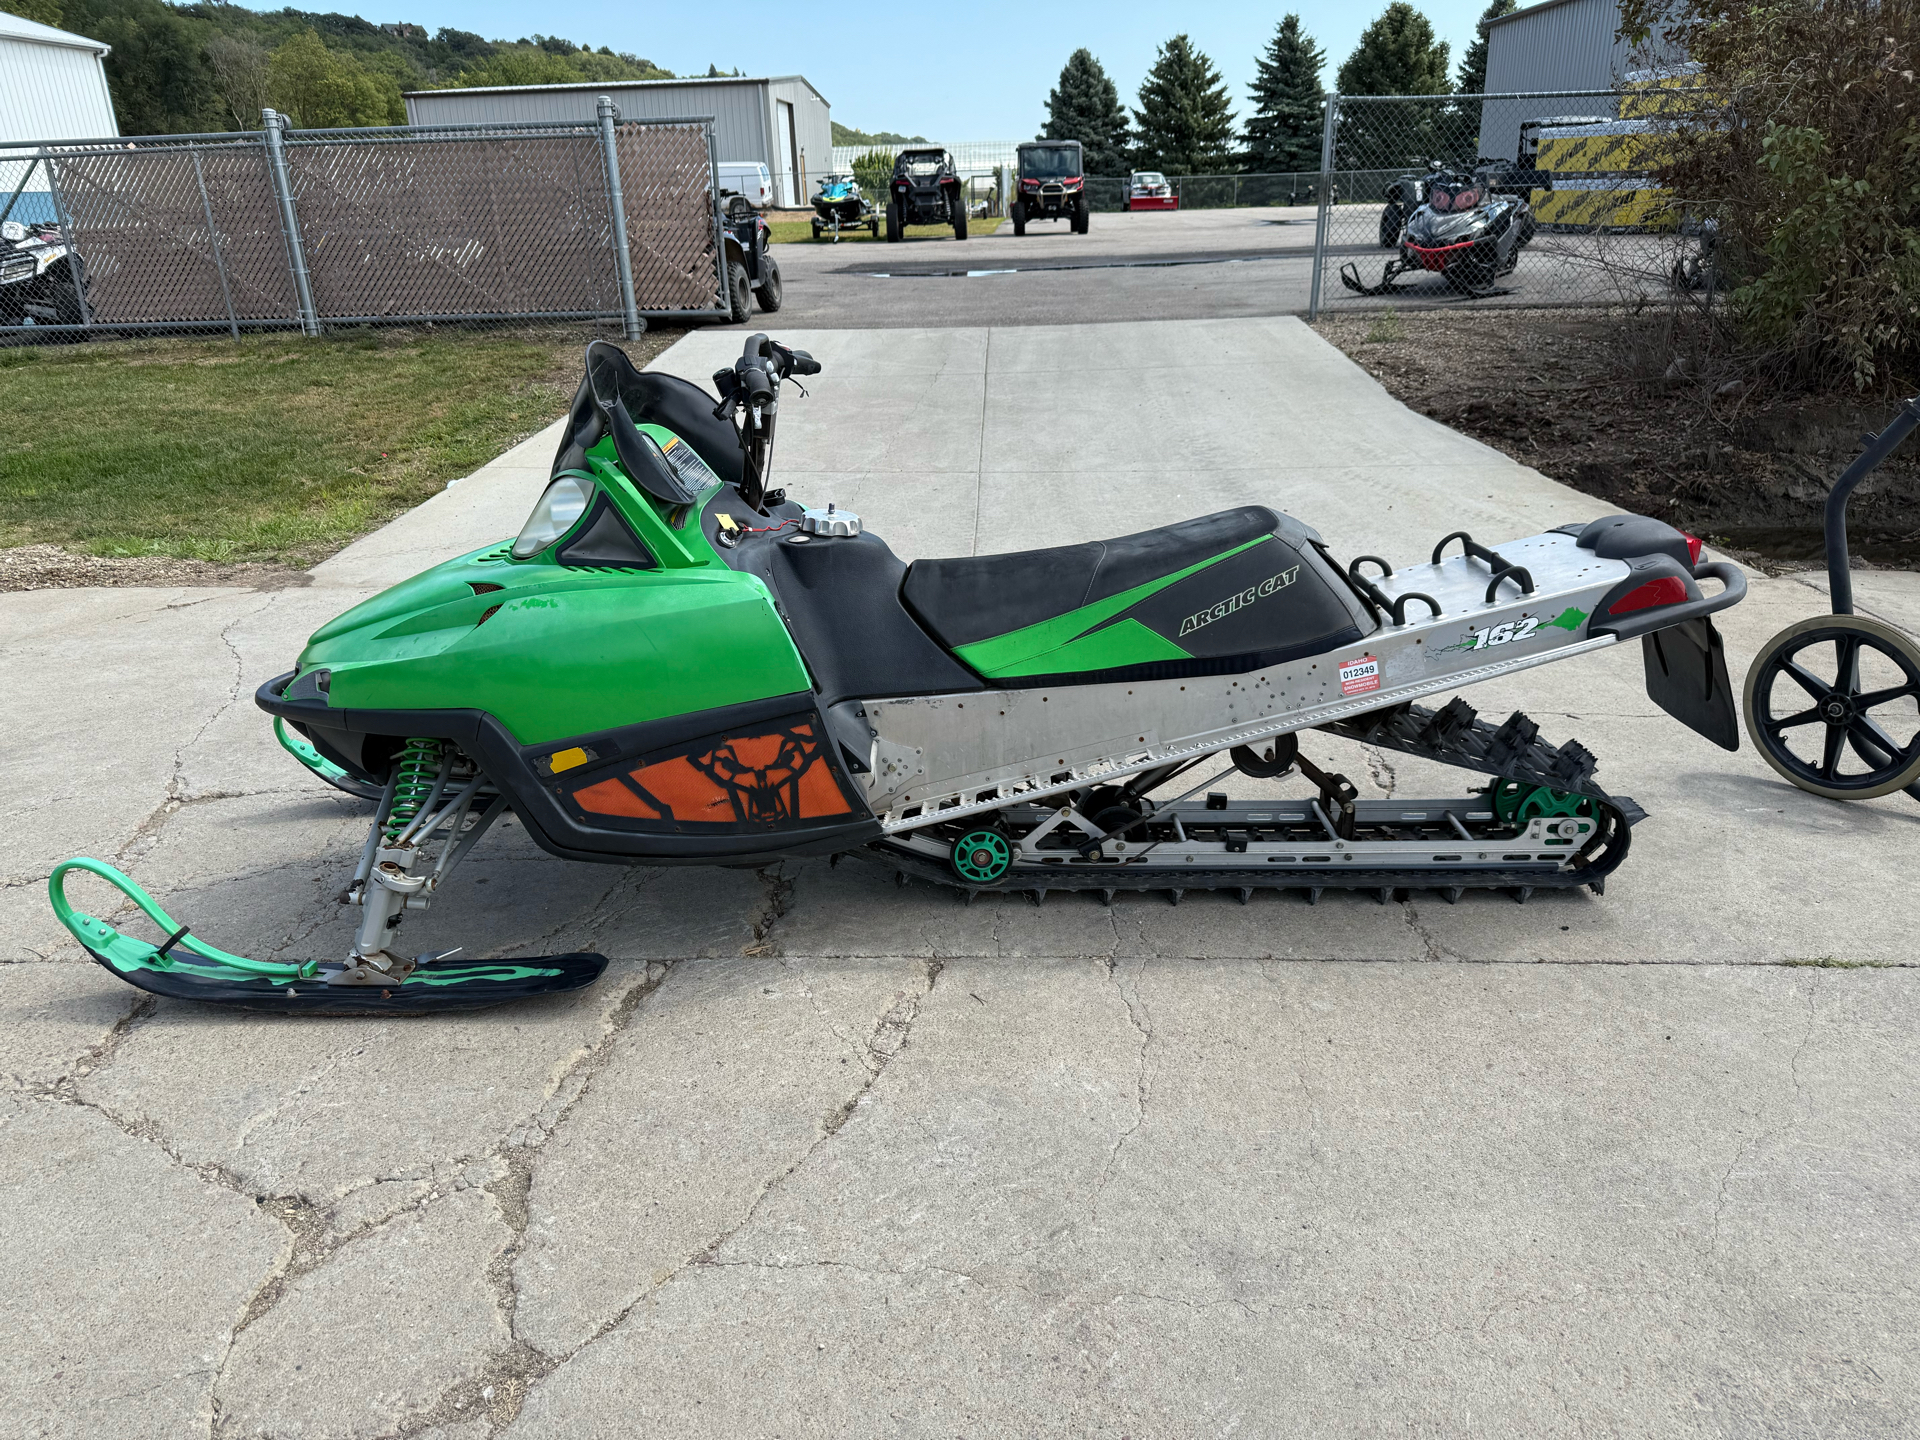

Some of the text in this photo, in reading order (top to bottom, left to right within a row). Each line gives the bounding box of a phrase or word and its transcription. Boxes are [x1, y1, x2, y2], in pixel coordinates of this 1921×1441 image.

[1179, 564, 1300, 637] ARCTIC CAT
[1474, 617, 1540, 651] 162
[1347, 657, 1368, 666] IDAHO
[1343, 665, 1375, 680] 012349
[1343, 679, 1379, 691] SNOWMOBILE
